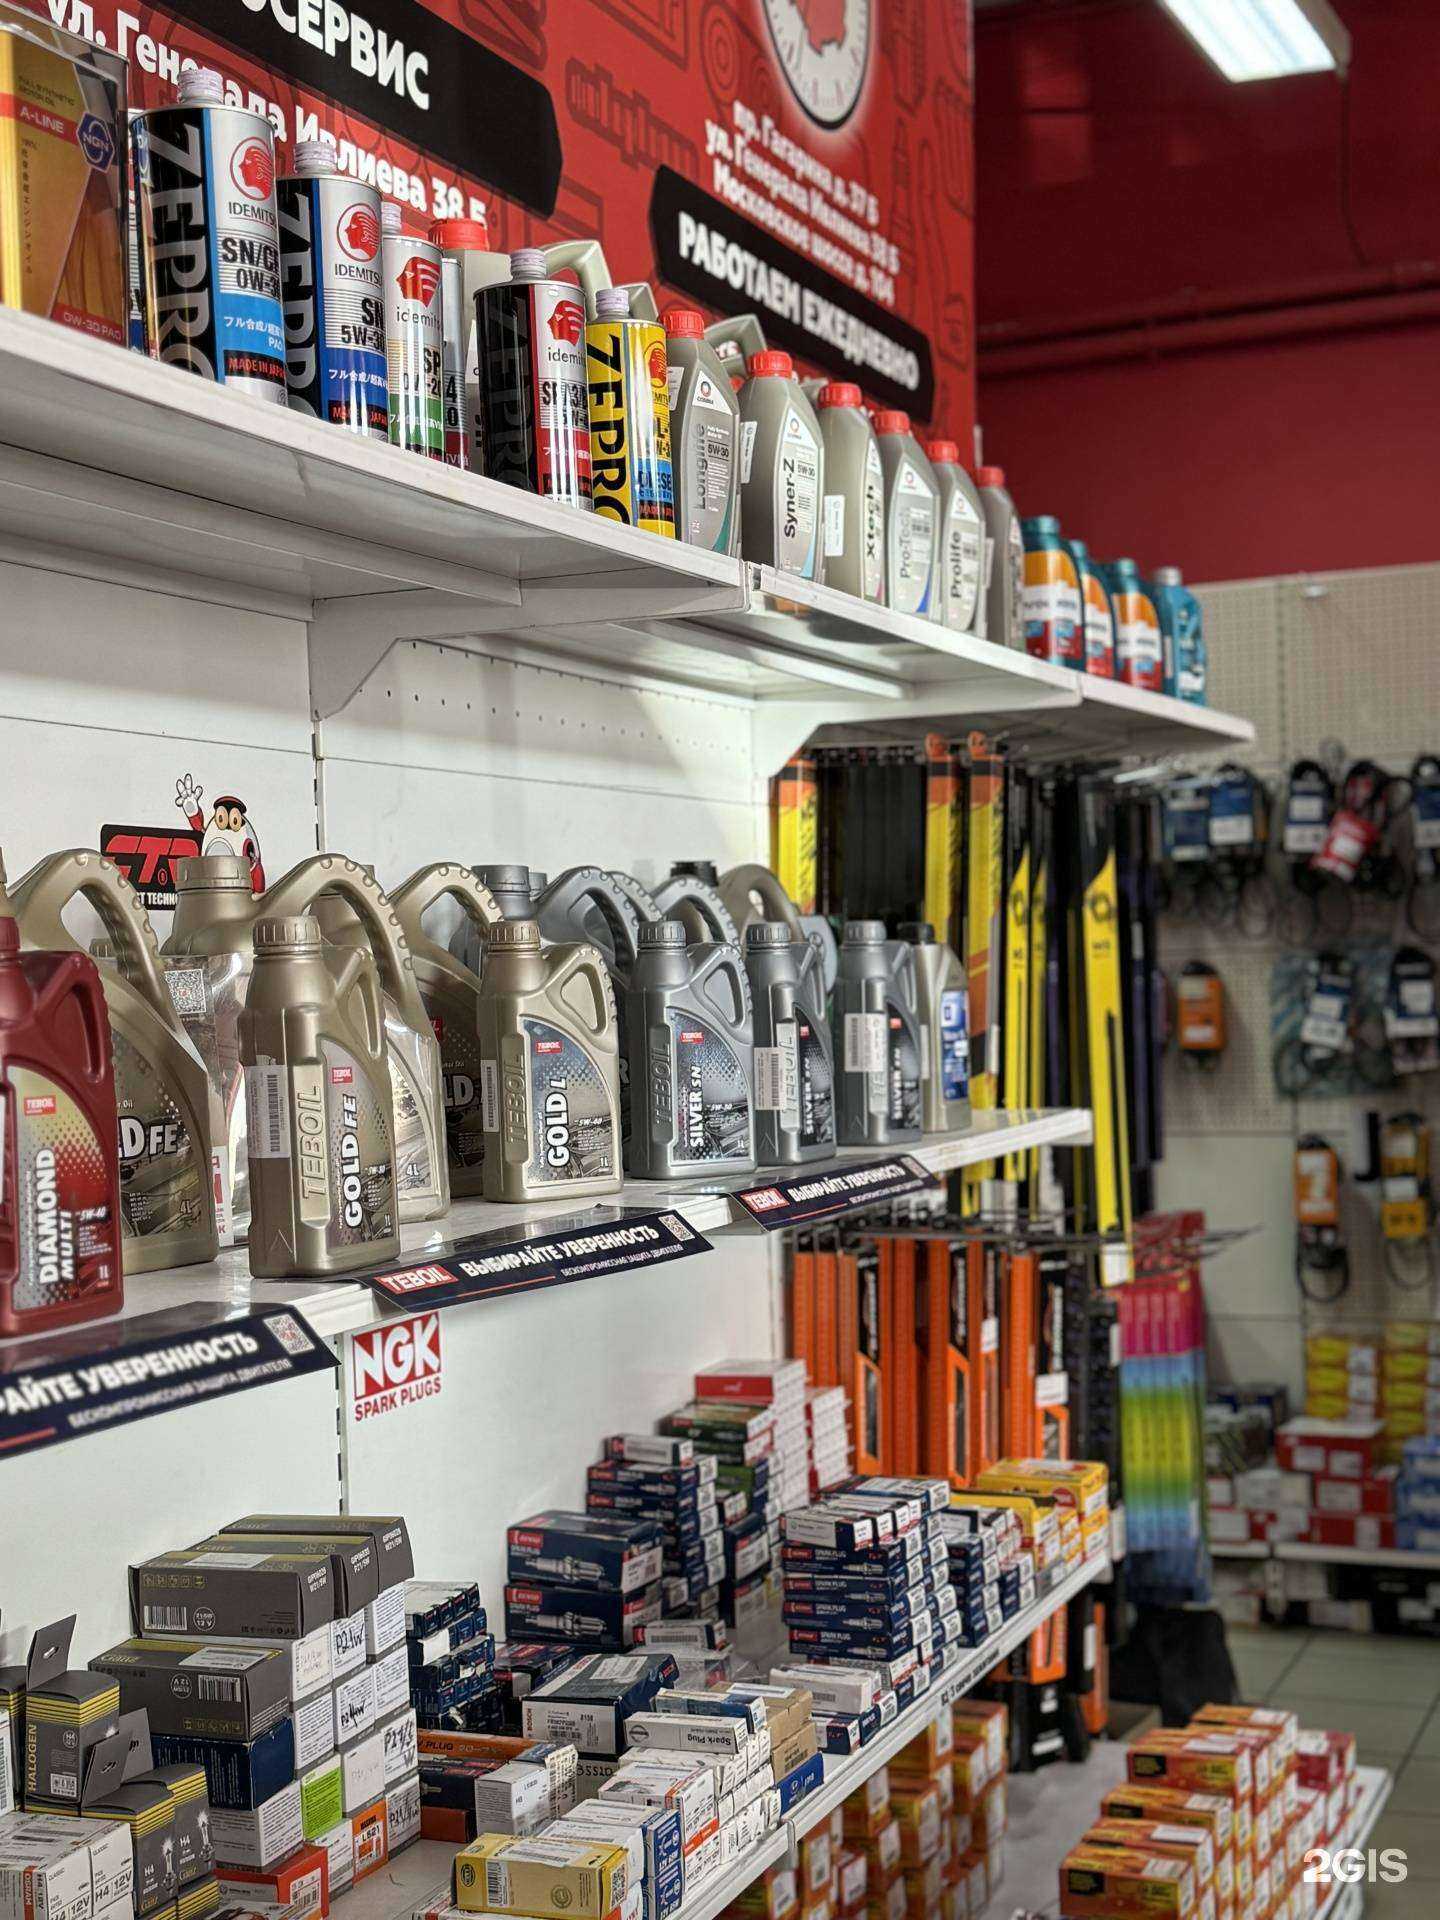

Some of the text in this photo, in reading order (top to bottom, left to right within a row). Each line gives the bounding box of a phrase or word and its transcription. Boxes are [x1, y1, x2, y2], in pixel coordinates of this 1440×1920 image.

[20, 105, 65, 135] A-LINE
[228, 201, 280, 229] IDEMITS
[396, 307, 442, 332] idemits
[678, 210, 921, 392] РАБОТАЕМ ЕЖЕДНЕВНО
[783, 458, 798, 538] Syner-Z
[503, 1054, 528, 1144] TEBOIL
[690, 1065, 704, 1147] SILVER SN
[149, 1123, 179, 1155] FE
[298, 1086, 329, 1199] TEBOIL
[545, 1091, 571, 1168] GOLD
[341, 1094, 363, 1228] GOLD FE
[787, 1176, 849, 1202] ВЫБИРАЙТЕ
[36, 1149, 59, 1285] DIAMOND
[80, 1207, 107, 1222] 5W-40
[60, 1211, 74, 1280] MULTI
[458, 1224, 661, 1278] ВЫБИРАЙТЕ УВЕРЕННОСТЬ
[382, 1267, 453, 1293] TEBOIL
[78, 1332, 259, 1395] УВЕРЕННОСТЬ
[354, 1315, 441, 1400] NGK
[354, 1376, 442, 1423] SPARK PLUGS
[28, 1724, 37, 1792] HALOGEN
[687, 1733, 732, 1746] Spark Plug
[70, 1894, 90, 1915] 12V
[95, 1870, 133, 1902] H4 12V
